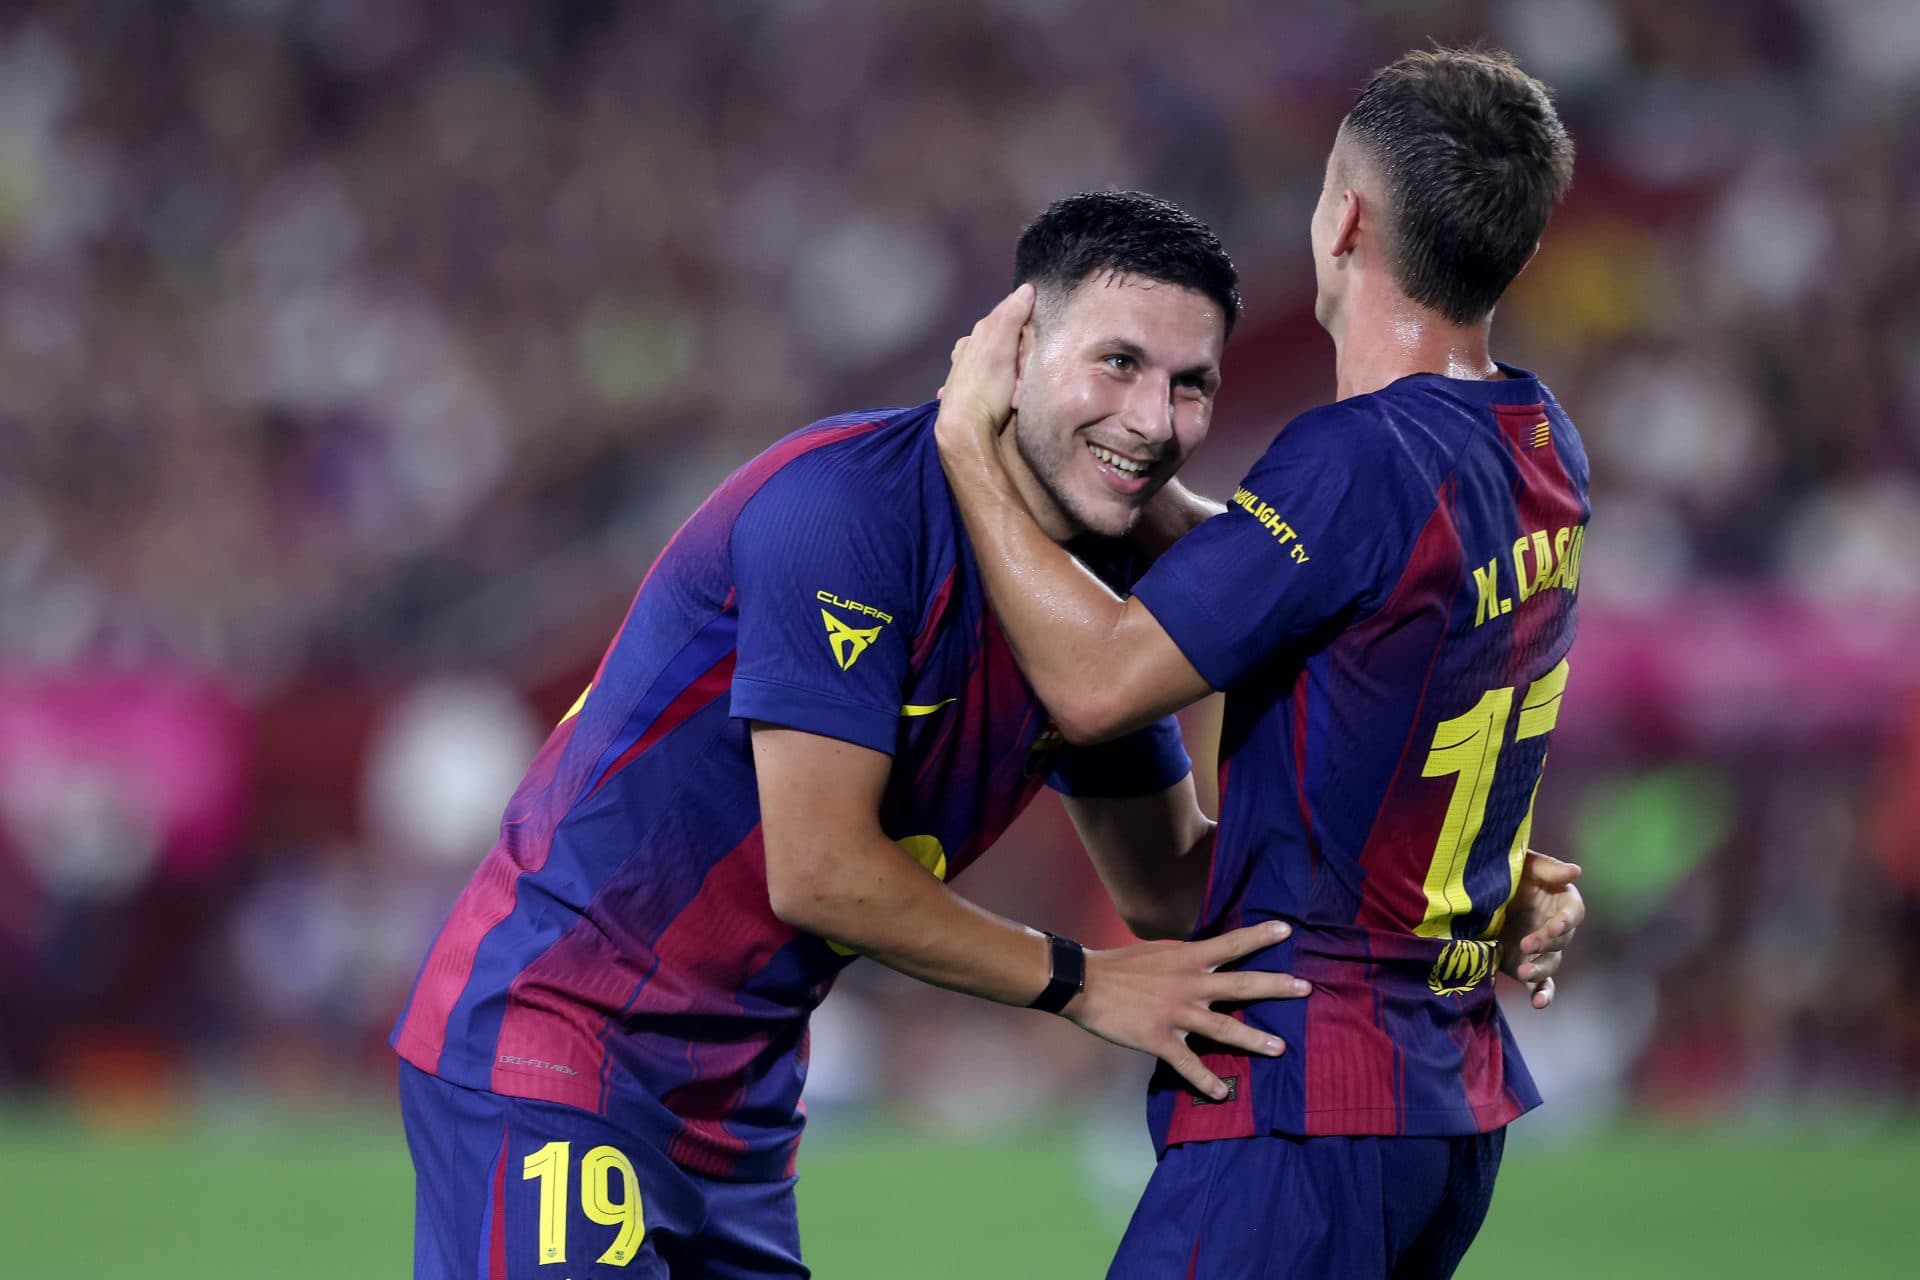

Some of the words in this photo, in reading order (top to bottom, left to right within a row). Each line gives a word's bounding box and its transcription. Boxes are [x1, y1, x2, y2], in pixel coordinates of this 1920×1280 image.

[1290, 544, 1310, 564] tv
[817, 590, 893, 624] CUPRA
[1412, 657, 1570, 939] 17
[523, 1141, 645, 1267] 19
